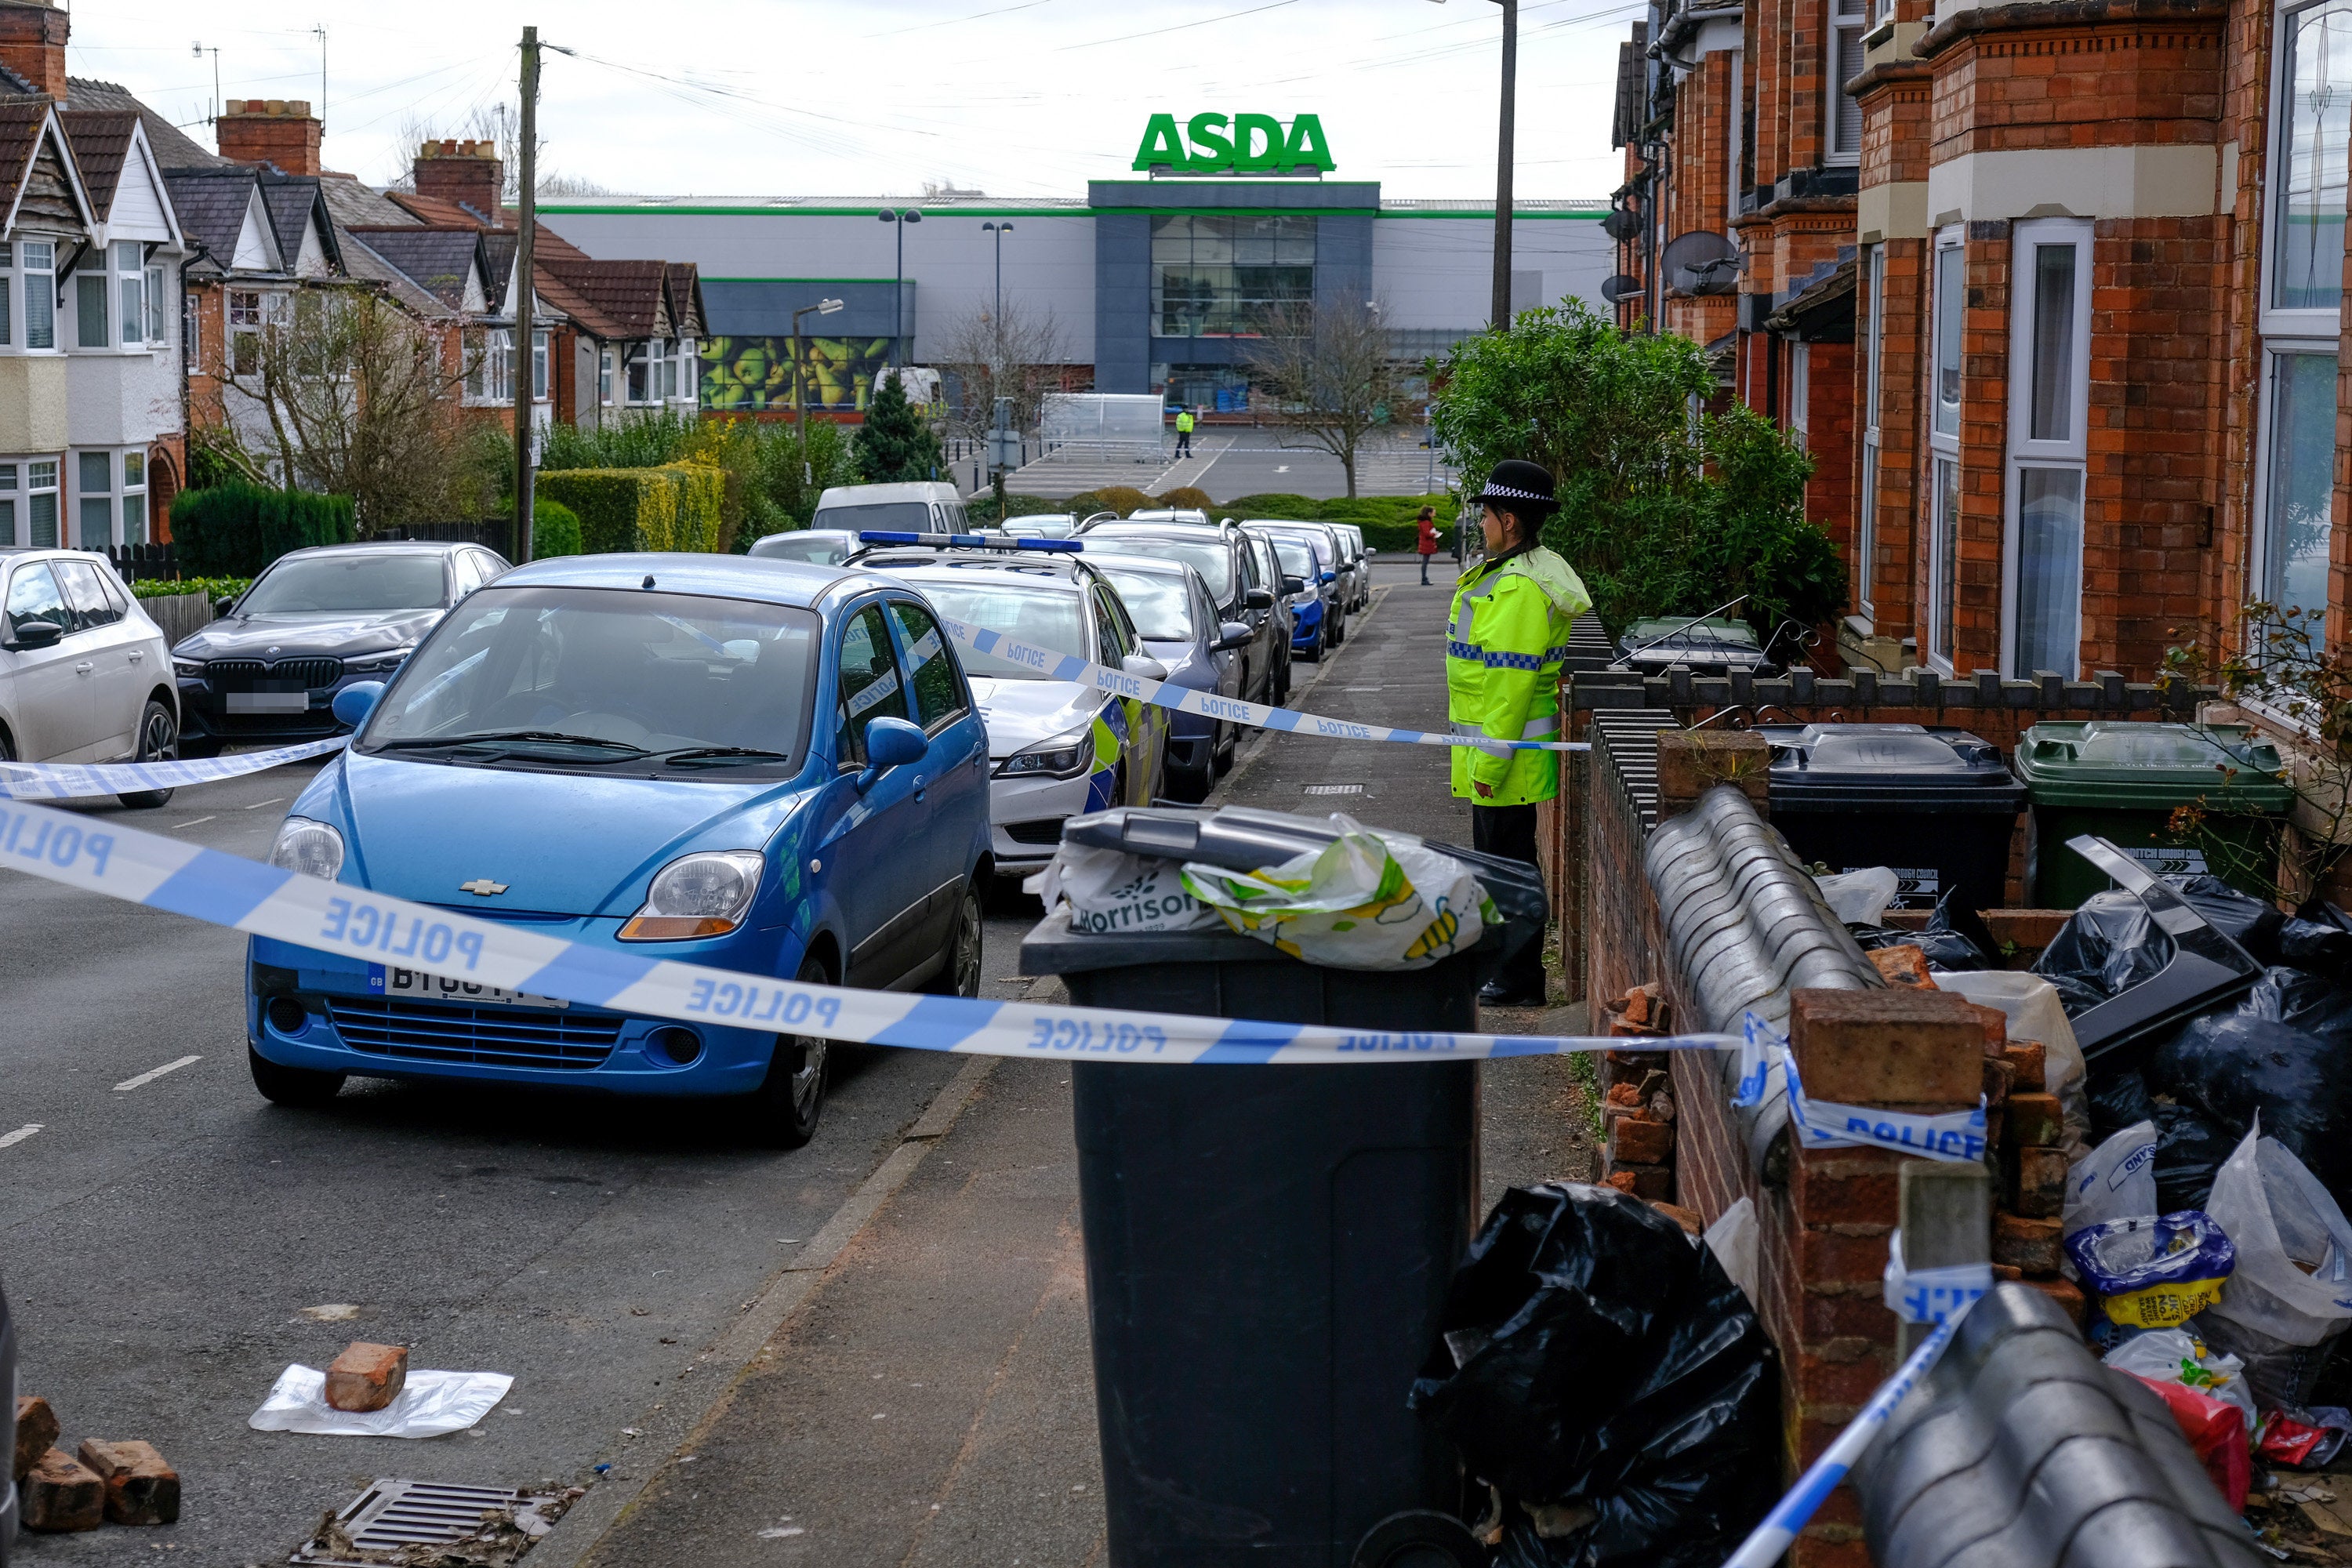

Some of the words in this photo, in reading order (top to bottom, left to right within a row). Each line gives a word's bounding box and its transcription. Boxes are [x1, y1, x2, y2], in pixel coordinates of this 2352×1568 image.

[1132, 112, 1337, 173] ASDA
[852, 677, 896, 710] POLICE
[1916, 869, 1938, 879] COUNCIL
[371, 977, 383, 986] GB
[2125, 1146, 2156, 1171] SAND
[2145, 1296, 2155, 1323] WATER
[2151, 1296, 2161, 1322] SPRING
[2169, 1294, 2181, 1321] UK'S
